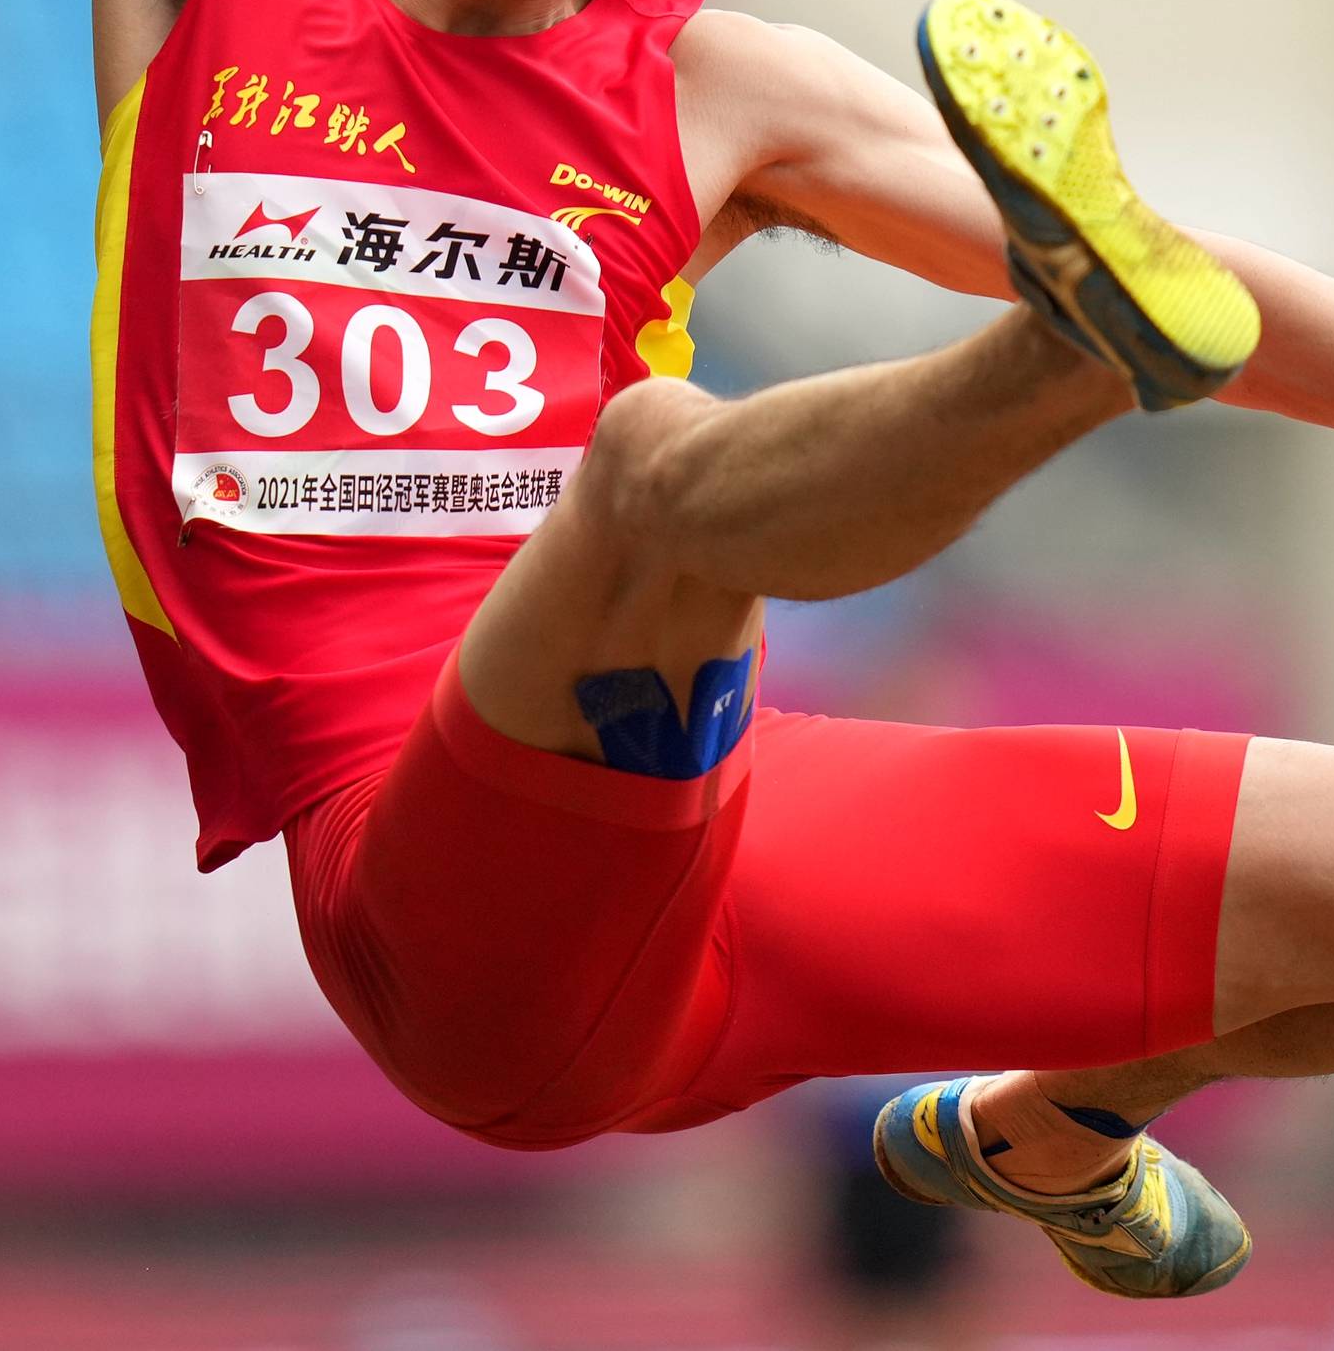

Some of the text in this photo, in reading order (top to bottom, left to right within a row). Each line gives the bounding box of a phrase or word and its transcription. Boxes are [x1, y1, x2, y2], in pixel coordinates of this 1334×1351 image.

[208, 244, 317, 262] HEALTH
[336, 211, 571, 292] 海尔斯
[227, 291, 546, 438] 303
[257, 468, 564, 513] 2021年全国田径冠军赛暨奥运会选拔赛
[712, 688, 736, 717] KT
